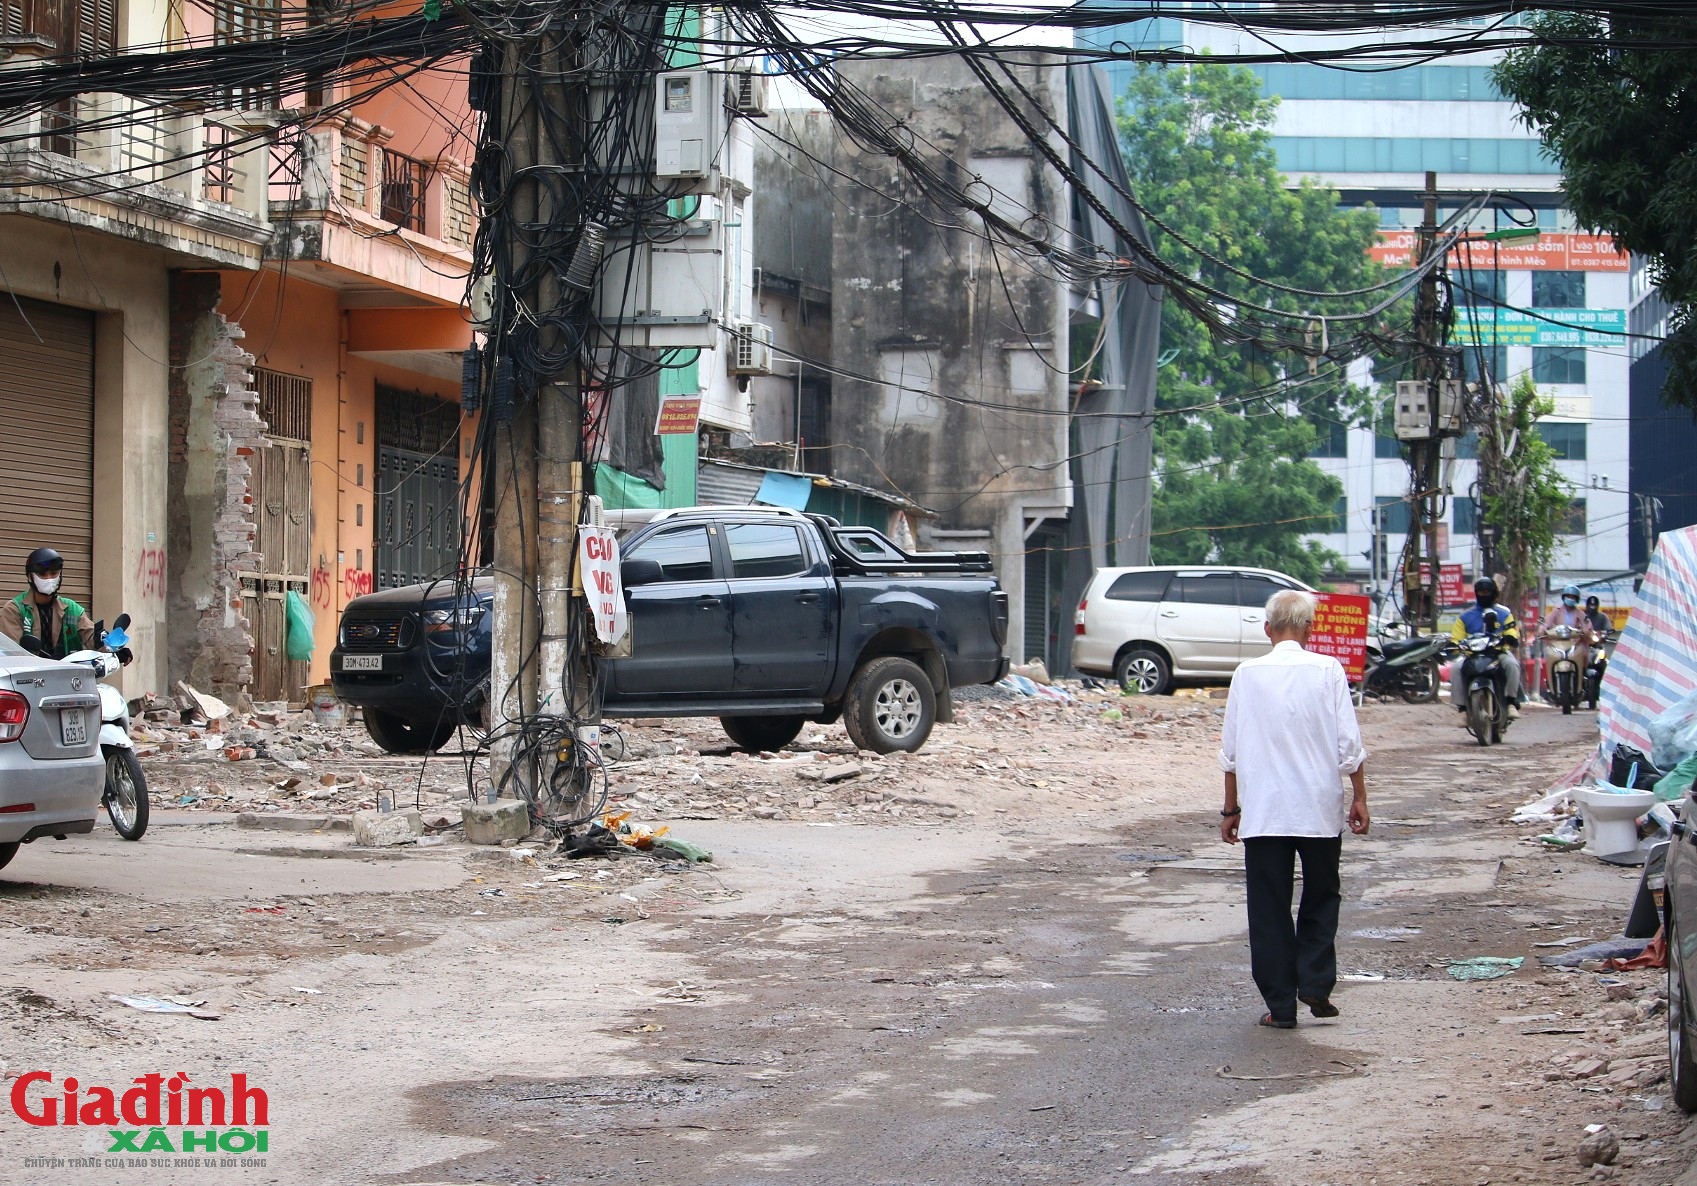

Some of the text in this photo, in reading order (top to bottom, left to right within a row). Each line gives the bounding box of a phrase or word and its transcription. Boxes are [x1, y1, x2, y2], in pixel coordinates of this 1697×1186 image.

[1538, 237, 1565, 252] sắm
[1576, 241, 1593, 251] vào
[1501, 255, 1522, 266] hình
[1524, 256, 1546, 266] Mèo
[1579, 312, 1596, 322] CHO
[1333, 604, 1363, 616] CHỮA
[1328, 613, 1366, 626] DƯỠNG
[1335, 624, 1357, 637] ĐẶT
[1346, 637, 1366, 648] LẠNH
